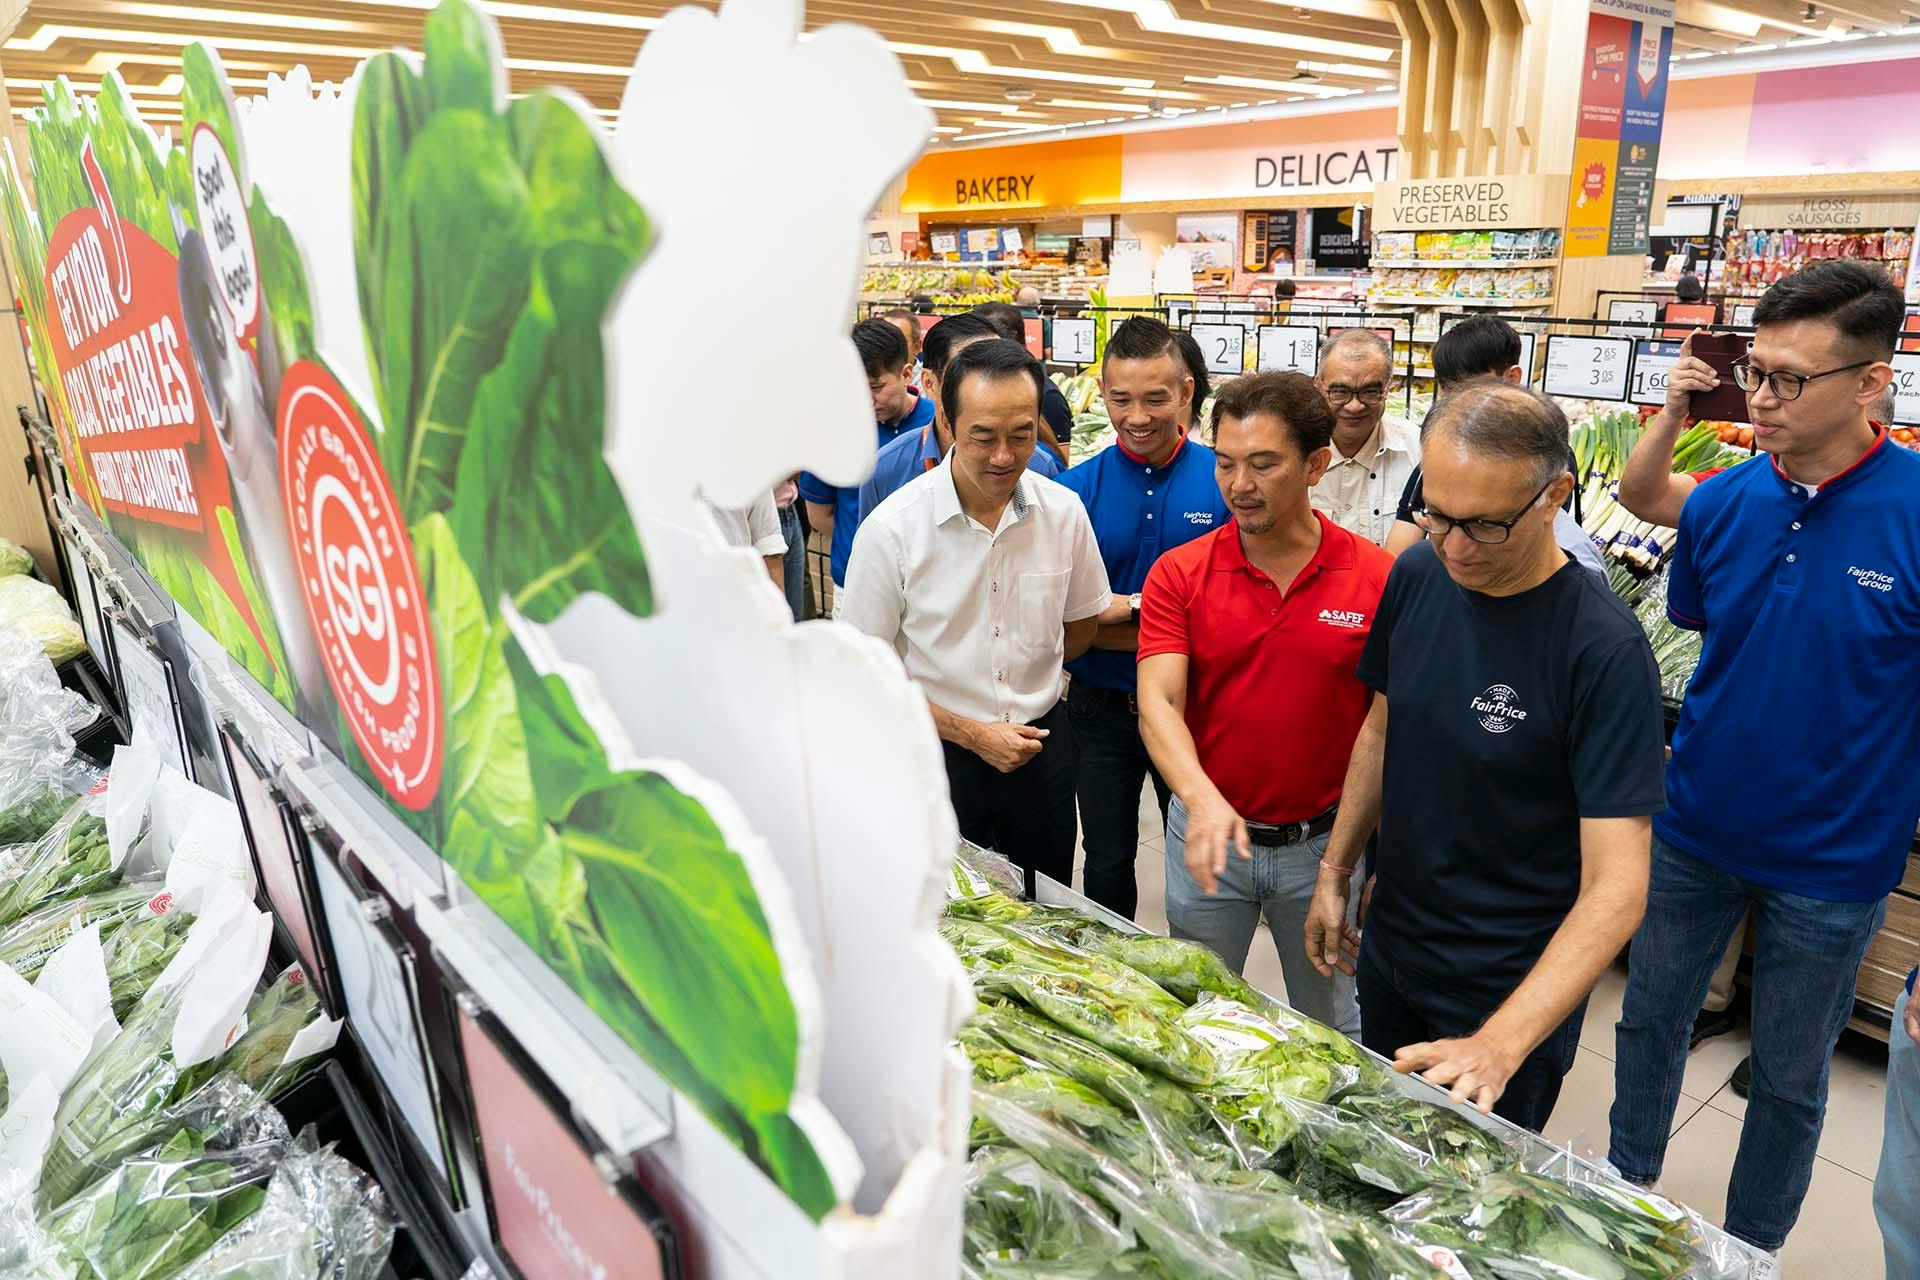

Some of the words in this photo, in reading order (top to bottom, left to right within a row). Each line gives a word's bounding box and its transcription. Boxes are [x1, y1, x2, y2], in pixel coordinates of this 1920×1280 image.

[1255, 148, 1397, 188] DELICAT
[198, 153, 225, 214] Spot
[956, 175, 1035, 205] BAKERY
[1400, 182, 1504, 204] PRESERVED
[1392, 203, 1509, 224] VEGETABLES
[1787, 212, 1861, 225] SAUSAGES
[1803, 199, 1855, 212] FLOSS/
[212, 206, 236, 251] this
[65, 225, 120, 337] YOUR
[221, 250, 252, 306] logo!
[52, 259, 84, 351] GET
[63, 360, 104, 439] LOCAL
[90, 315, 195, 434] VEGETABLES
[112, 449, 144, 508] THIS
[132, 447, 199, 516] BANNER!
[319, 424, 394, 558] GROWN
[1183, 511, 1213, 519] FairPrice
[1847, 565, 1895, 584] FairPrice
[1857, 576, 1893, 593] Group
[326, 544, 385, 641] SG
[1331, 609, 1365, 624] SAFEF
[322, 618, 378, 736] FRESH
[381, 631, 421, 754] PRODUCE
[1493, 687, 1512, 696] MADE
[1470, 696, 1528, 720] FairPrice
[1484, 720, 1505, 731] GOOD
